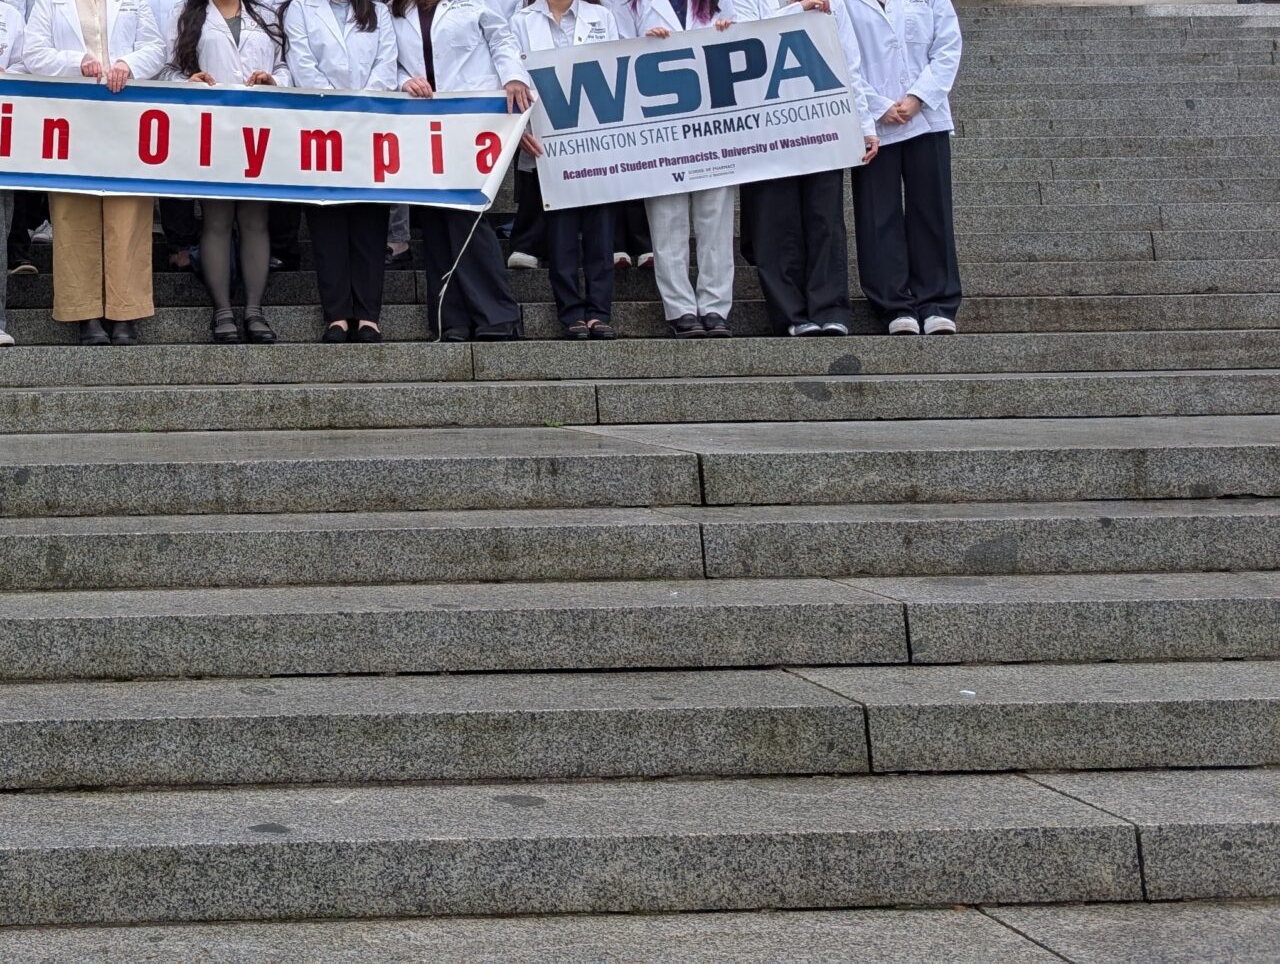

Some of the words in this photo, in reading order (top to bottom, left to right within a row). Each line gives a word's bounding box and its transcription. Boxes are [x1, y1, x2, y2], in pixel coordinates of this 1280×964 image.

[528, 29, 846, 130] WSPA
[0, 103, 70, 160] in
[138, 109, 502, 183] Olympia
[543, 131, 637, 157] WASHINGTON
[640, 125, 680, 146] STATE
[682, 113, 761, 139] PHARMACY
[765, 98, 852, 127] ASSOCIATION
[563, 165, 607, 181] Academy
[609, 163, 620, 174] of
[620, 159, 658, 173] Student
[659, 150, 720, 168] Pharmacists,
[721, 143, 768, 159] University
[769, 139, 779, 151] of
[779, 131, 839, 150] Washington
[672, 171, 686, 183] W
